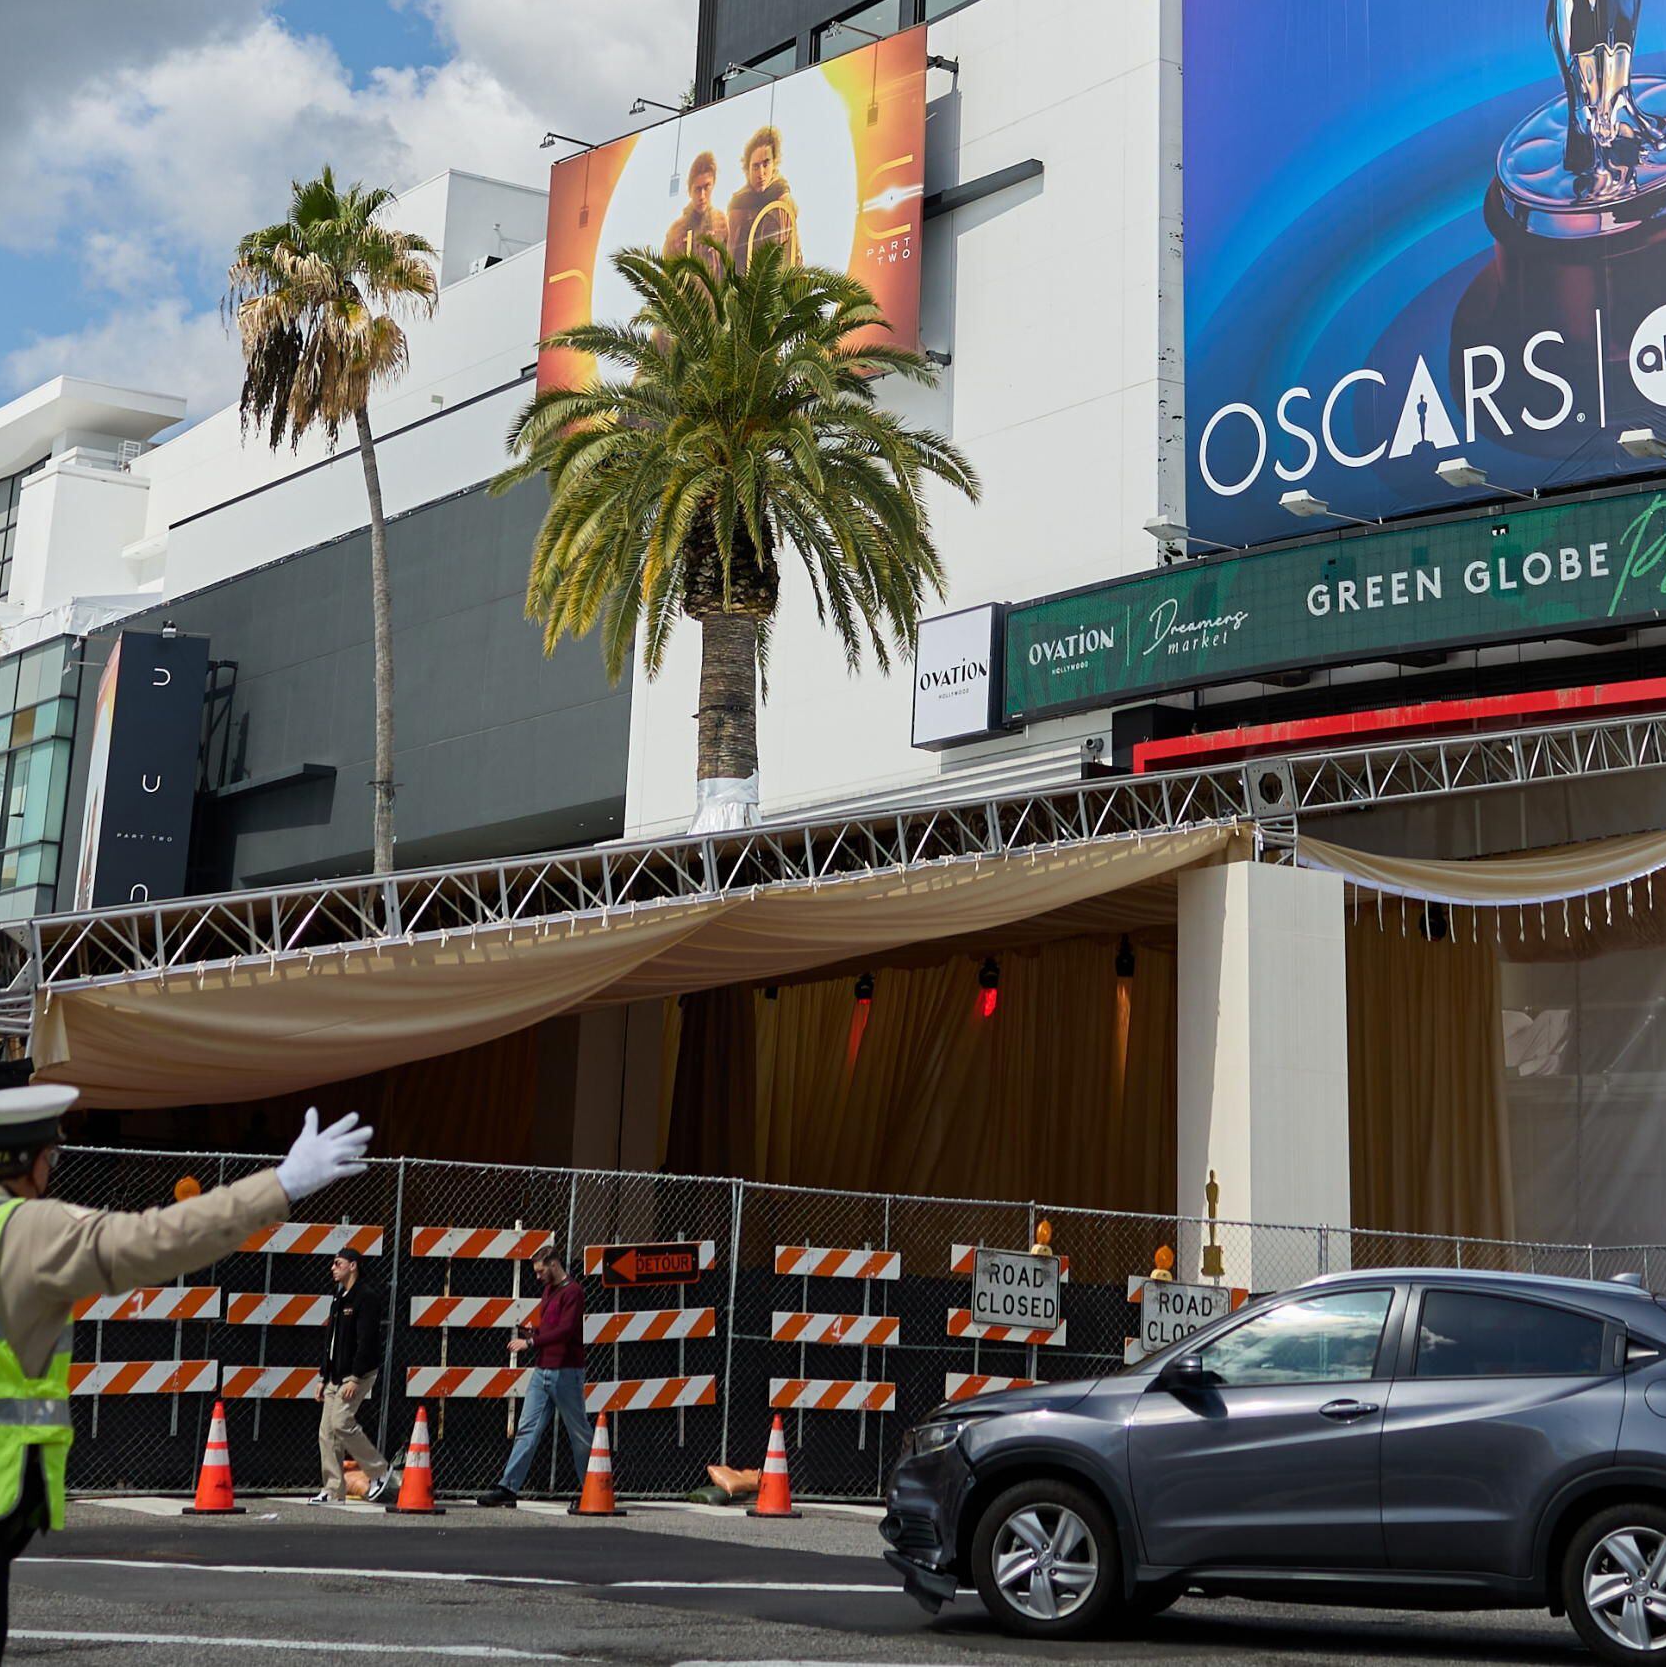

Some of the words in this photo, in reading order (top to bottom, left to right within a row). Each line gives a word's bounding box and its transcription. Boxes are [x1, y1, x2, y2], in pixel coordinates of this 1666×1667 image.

[866, 237, 912, 258] PART
[877, 248, 911, 266] TWO
[1199, 330, 1574, 496] OSCARS
[1307, 567, 1442, 617] GREEN
[1463, 542, 1610, 594] GLOBE
[1167, 628, 1229, 656] market
[1051, 661, 1089, 675] HOLLYWOOD
[636, 1256, 689, 1272] DETOUR
[989, 1263, 1044, 1288] ROAD
[976, 1291, 1055, 1319] CLOSED
[1158, 1292, 1213, 1317] ROAD
[1147, 1321, 1198, 1342] CLOS
